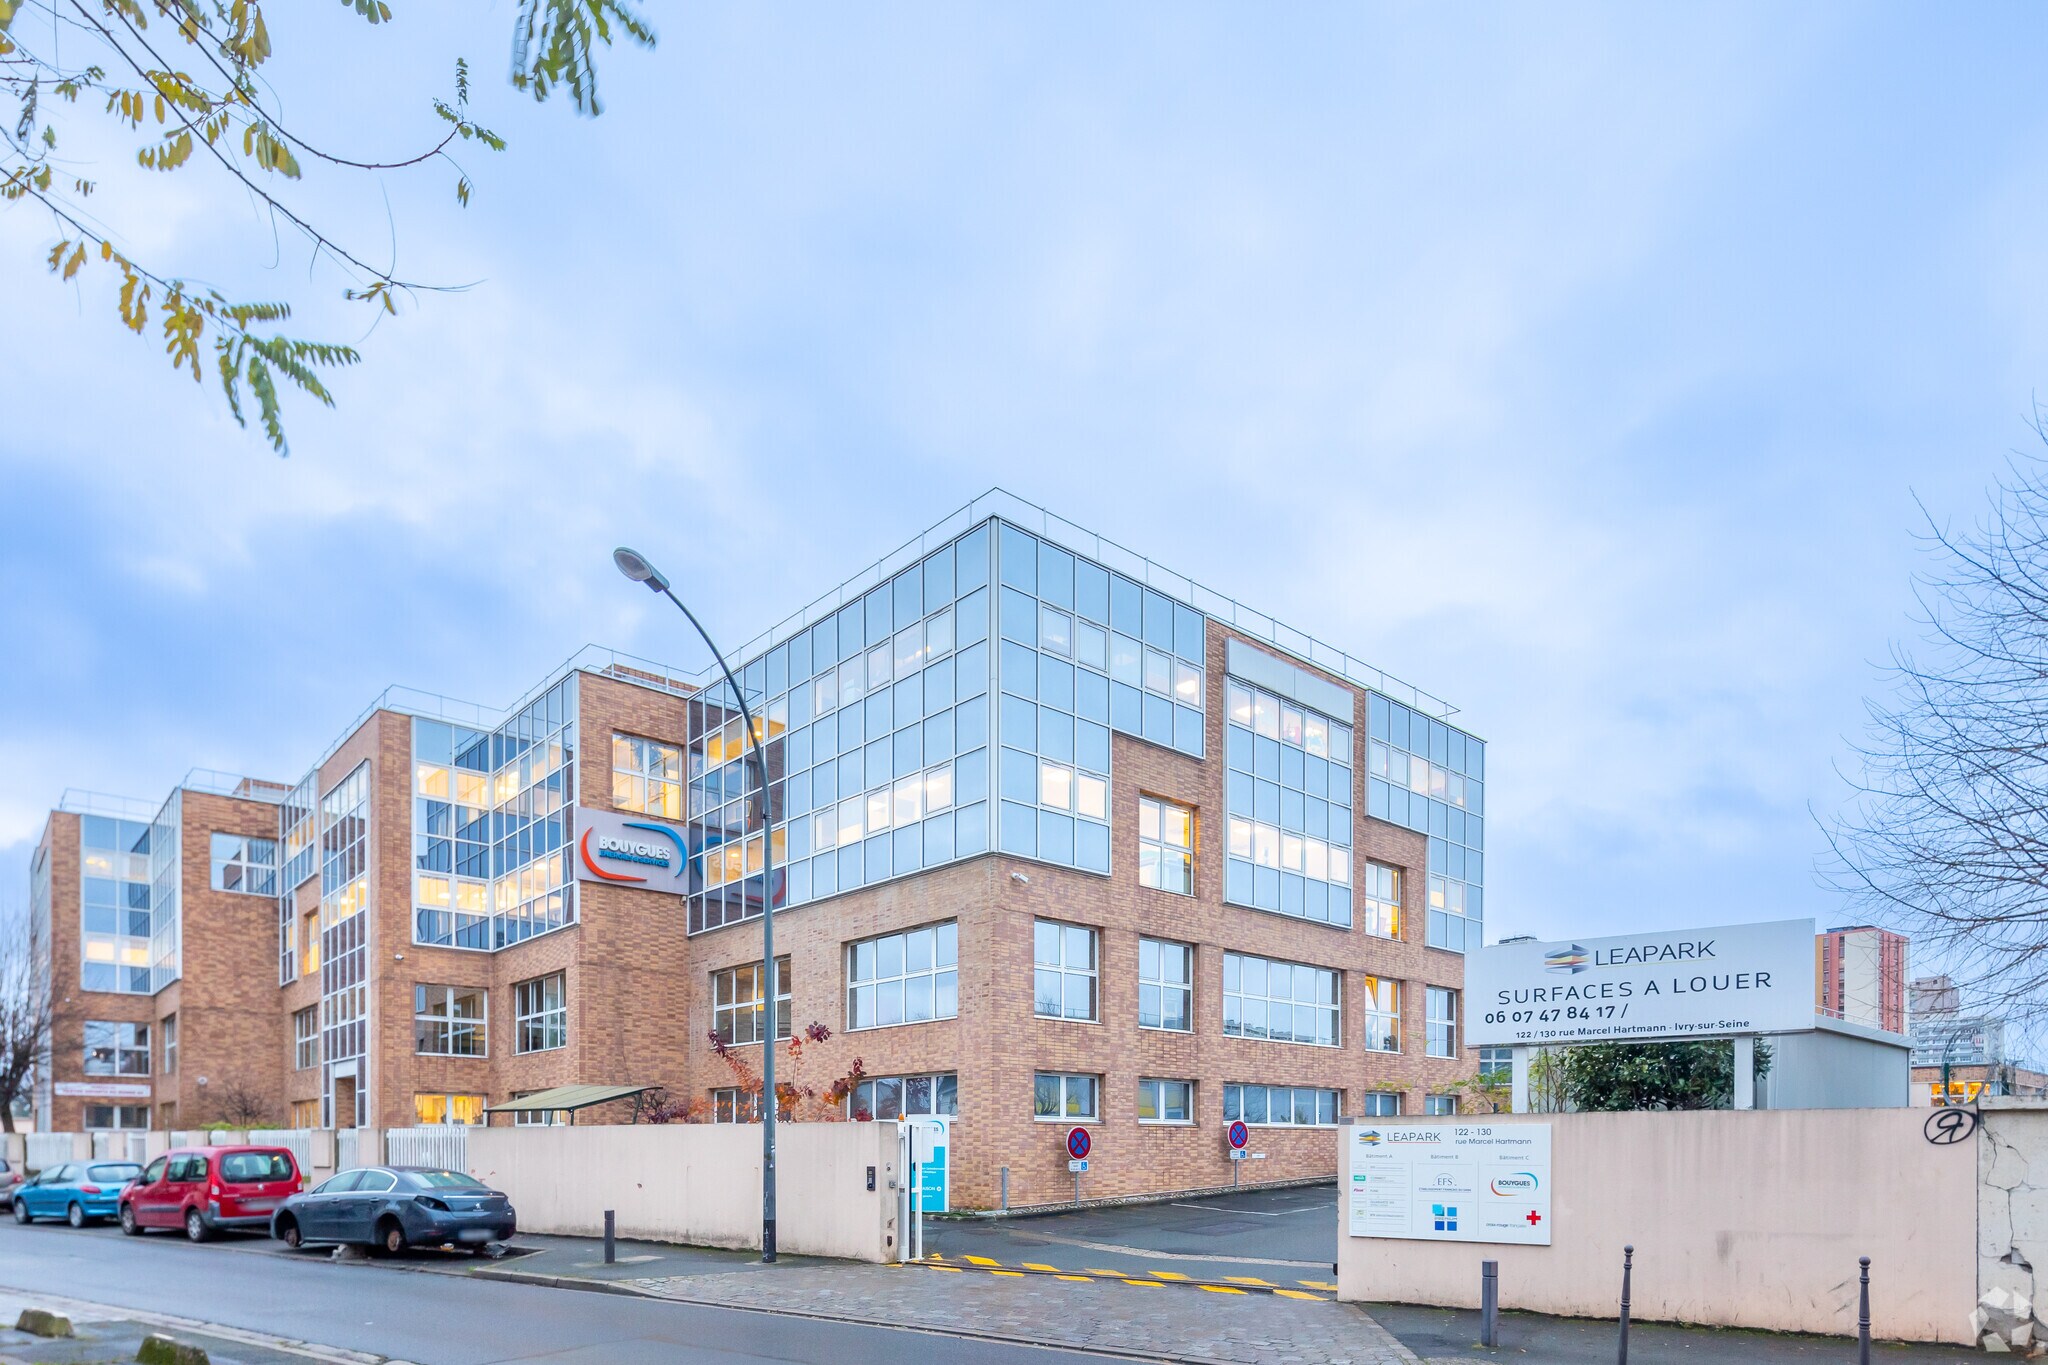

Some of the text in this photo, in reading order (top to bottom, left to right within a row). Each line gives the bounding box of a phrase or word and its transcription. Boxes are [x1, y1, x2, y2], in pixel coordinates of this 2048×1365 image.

[598, 835, 671, 860] BOUYGUES
[1595, 940, 1716, 966] LEAPARK
[1498, 972, 1772, 1005] SURFACES A LOUER
[1485, 1003, 1629, 1024] 06 07 47 84 17 /
[1516, 1031, 1532, 1039] 122
[1533, 1030, 1539, 1039] /
[1540, 1030, 1557, 1038] 130
[1577, 1026, 1611, 1036] Marcel
[1614, 1024, 1667, 1035] Hartmann
[1675, 1020, 1750, 1032] Ivry-sur-Seine
[1387, 1132, 1442, 1142] LEAPARK
[1454, 1128, 1469, 1136] 122
[1477, 1128, 1492, 1136] 130
[1437, 1177, 1453, 1186] EFS
